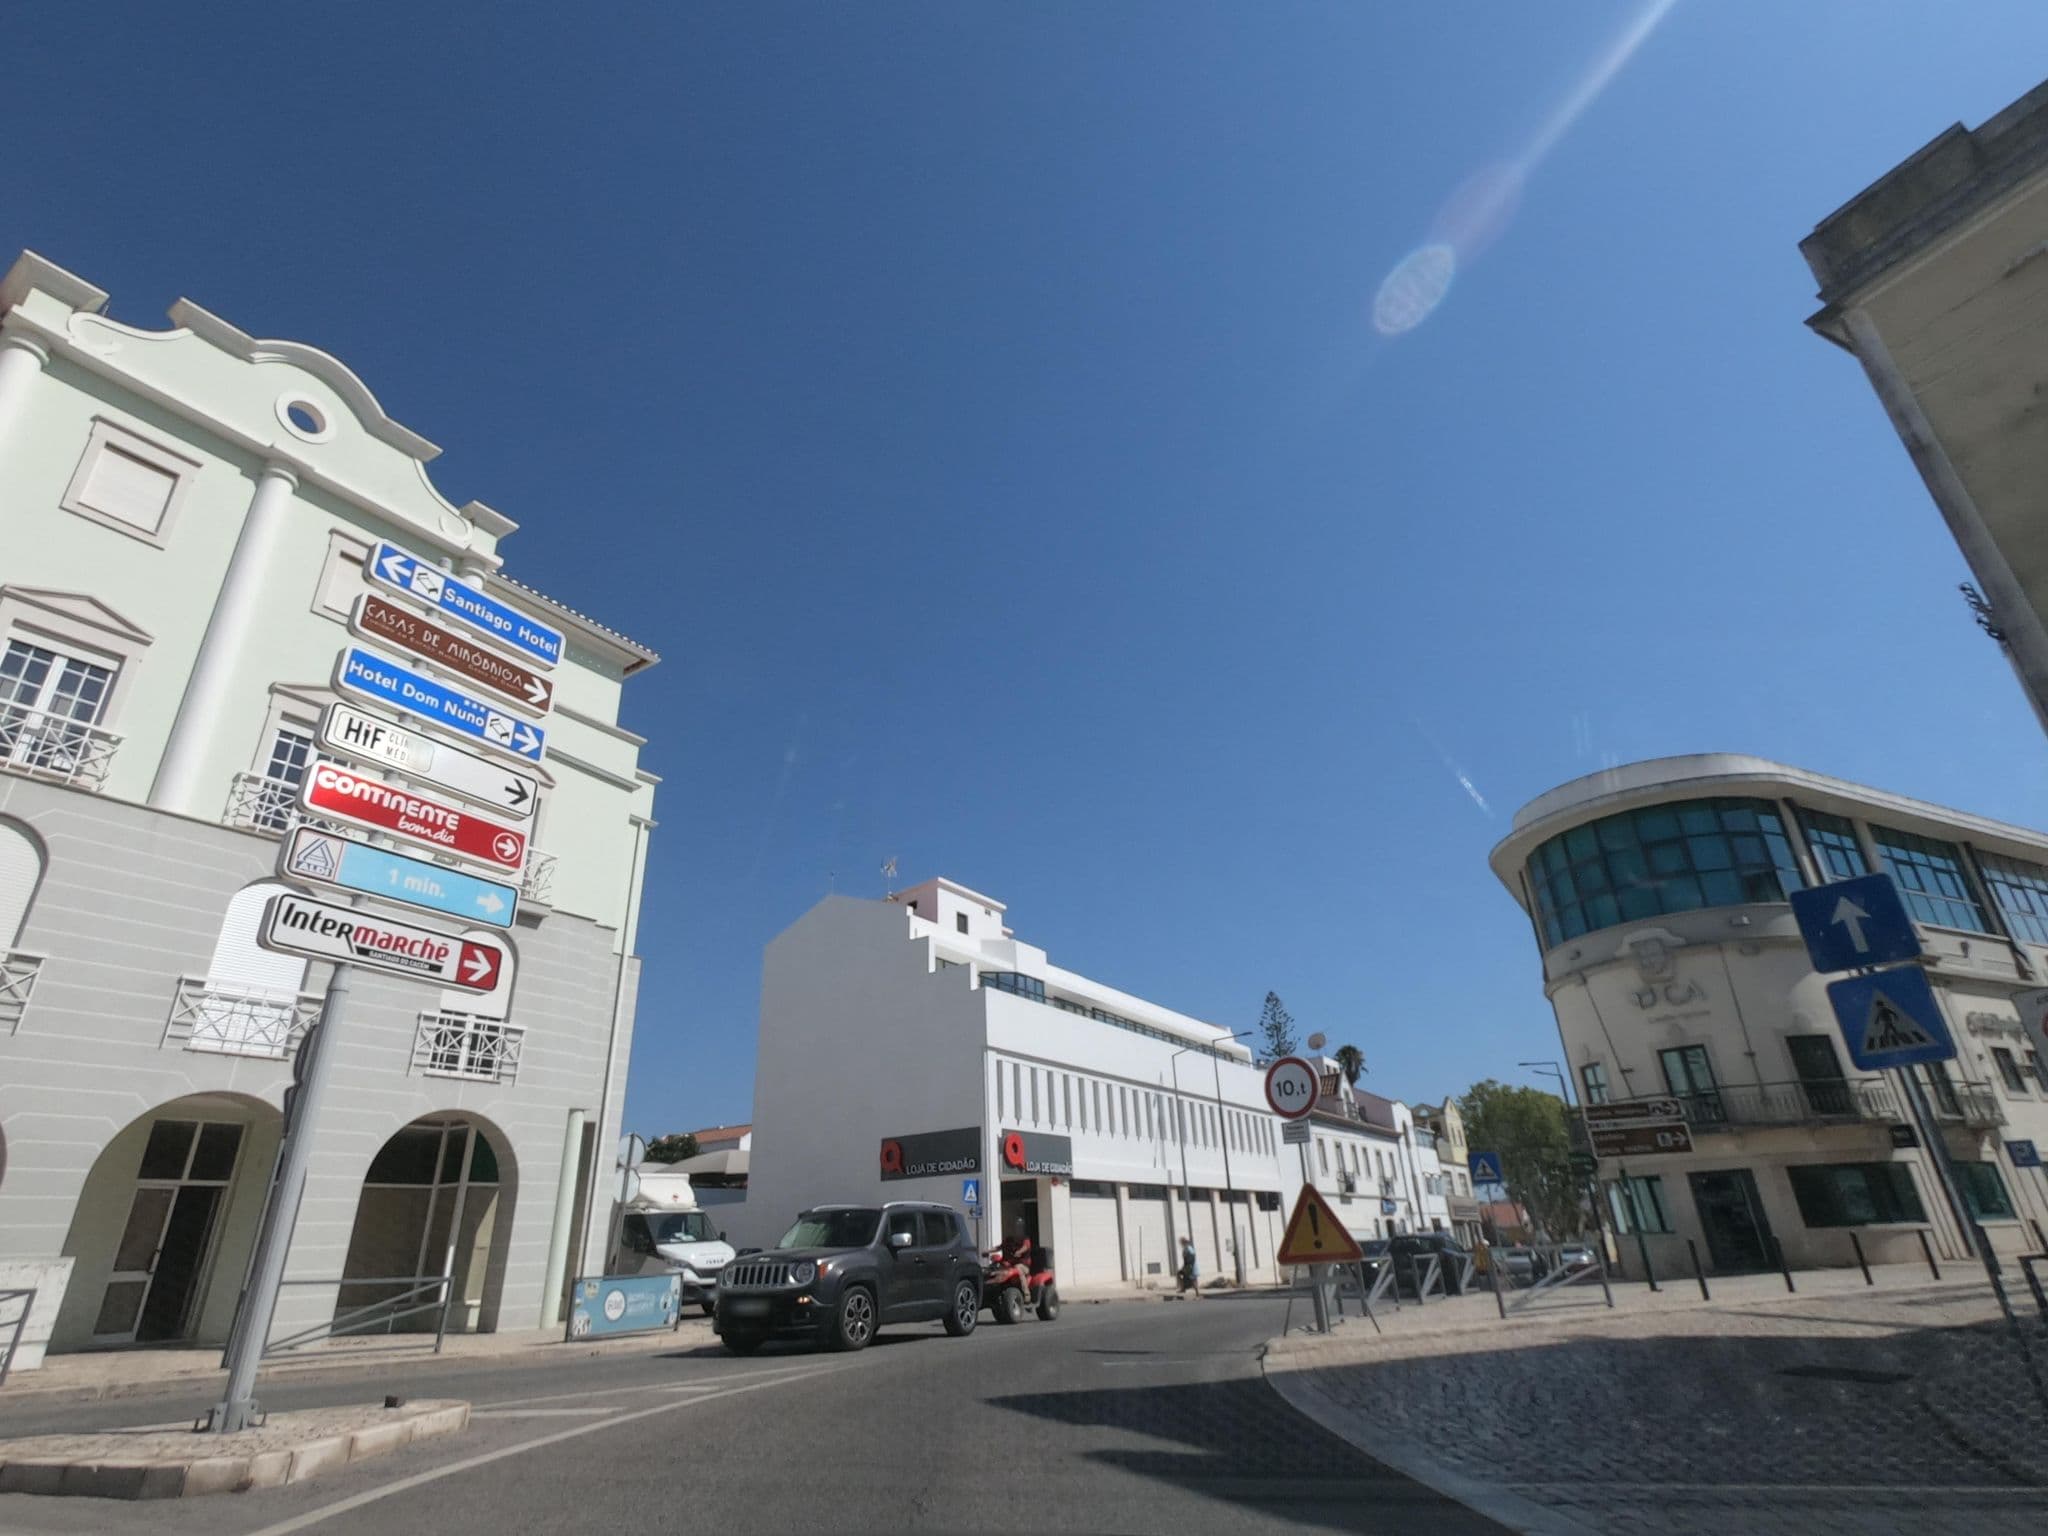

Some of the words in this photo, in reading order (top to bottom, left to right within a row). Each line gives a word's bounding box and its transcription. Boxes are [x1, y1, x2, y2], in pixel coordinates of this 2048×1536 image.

[366, 604, 415, 635] CASAS
[423, 630, 441, 647] DE
[444, 587, 513, 633] Santiago
[518, 626, 559, 656] Hotel
[349, 660, 398, 692] Hotel
[402, 682, 440, 709] Dom
[444, 700, 486, 728] Nuno
[317, 770, 461, 831] CONTINENTE
[398, 815, 432, 838] bom
[433, 827, 456, 846] dia
[297, 861, 332, 877] ALDI
[388, 869, 398, 885] 1
[404, 873, 446, 898] min.
[282, 903, 450, 963] Intermarché
[906, 1164, 926, 1176] LOJA
[926, 1162, 937, 1174] DE
[938, 1157, 976, 1173] CIDADÃO
[1026, 1161, 1040, 1172] LOJA
[1041, 1162, 1050, 1173] DE
